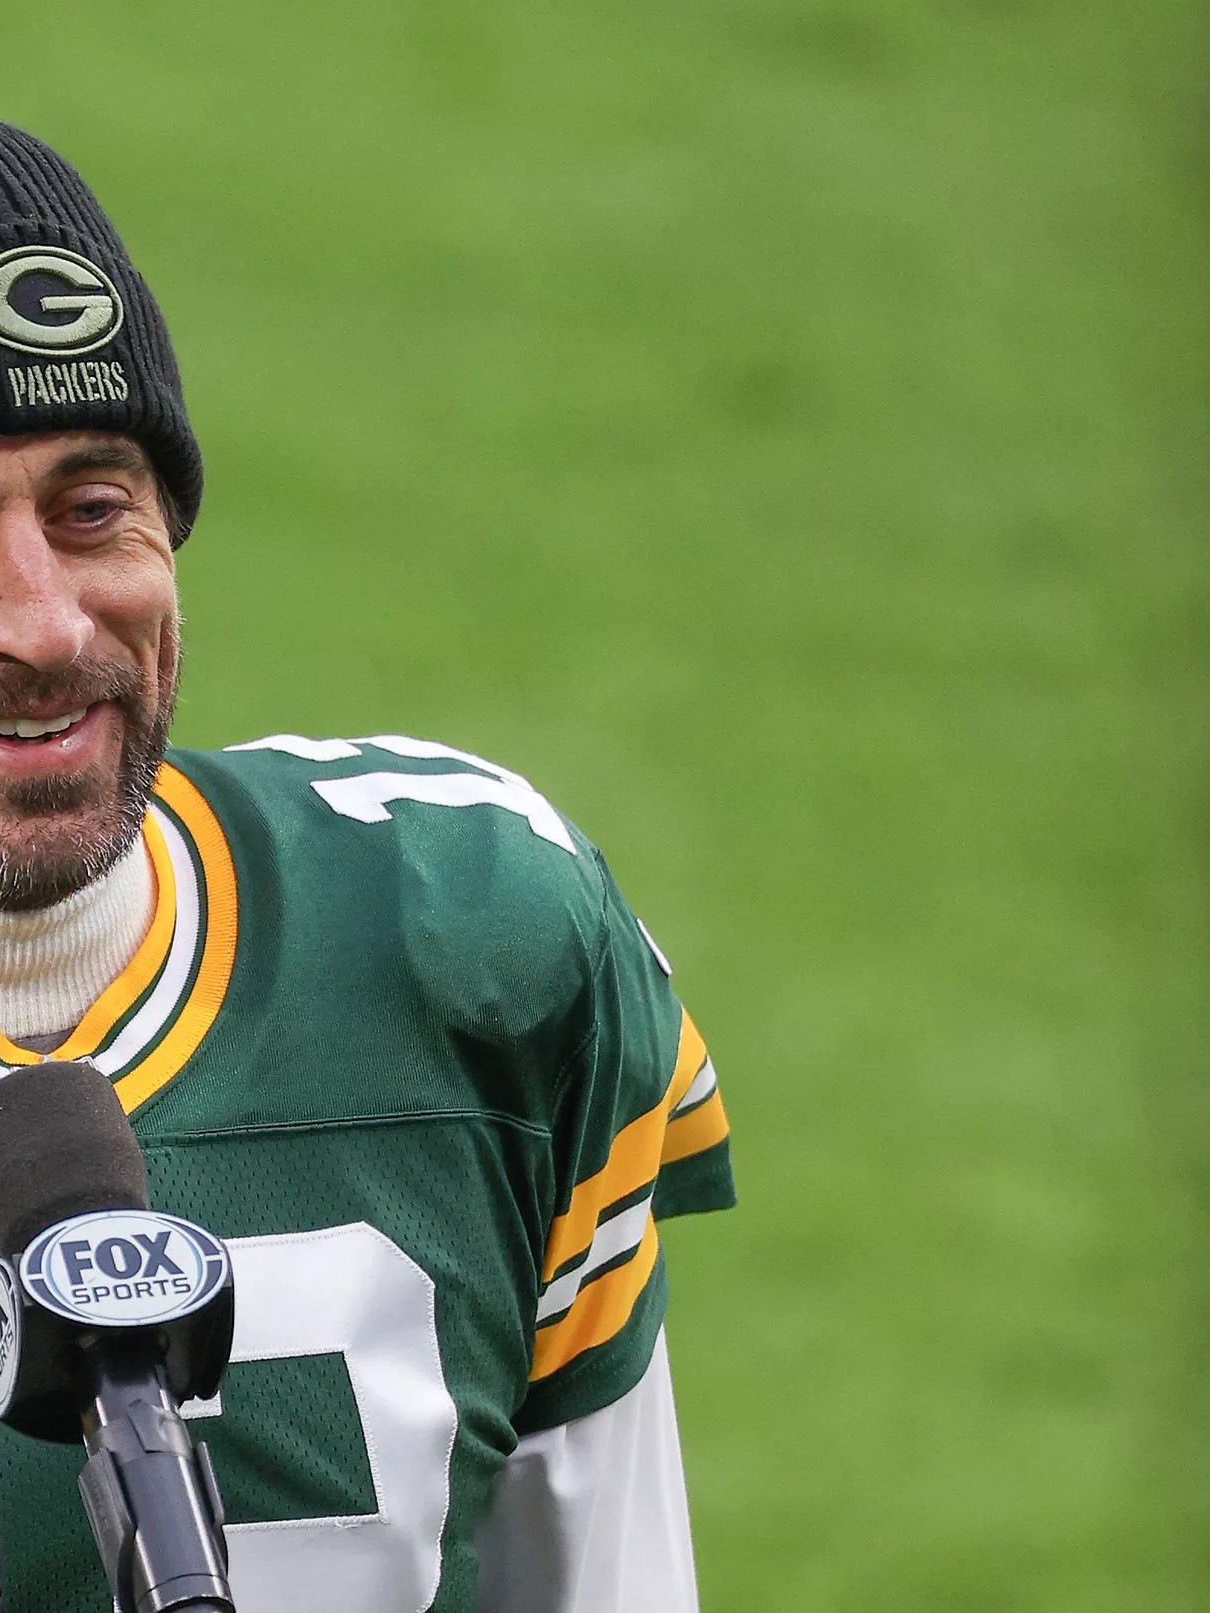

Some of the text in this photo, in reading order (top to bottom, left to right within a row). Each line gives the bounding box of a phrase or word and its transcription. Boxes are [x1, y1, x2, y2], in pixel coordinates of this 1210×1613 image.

[7, 361, 128, 407] PACKERS
[59, 1230, 185, 1286] FOX
[71, 1276, 192, 1306] SPORTS
